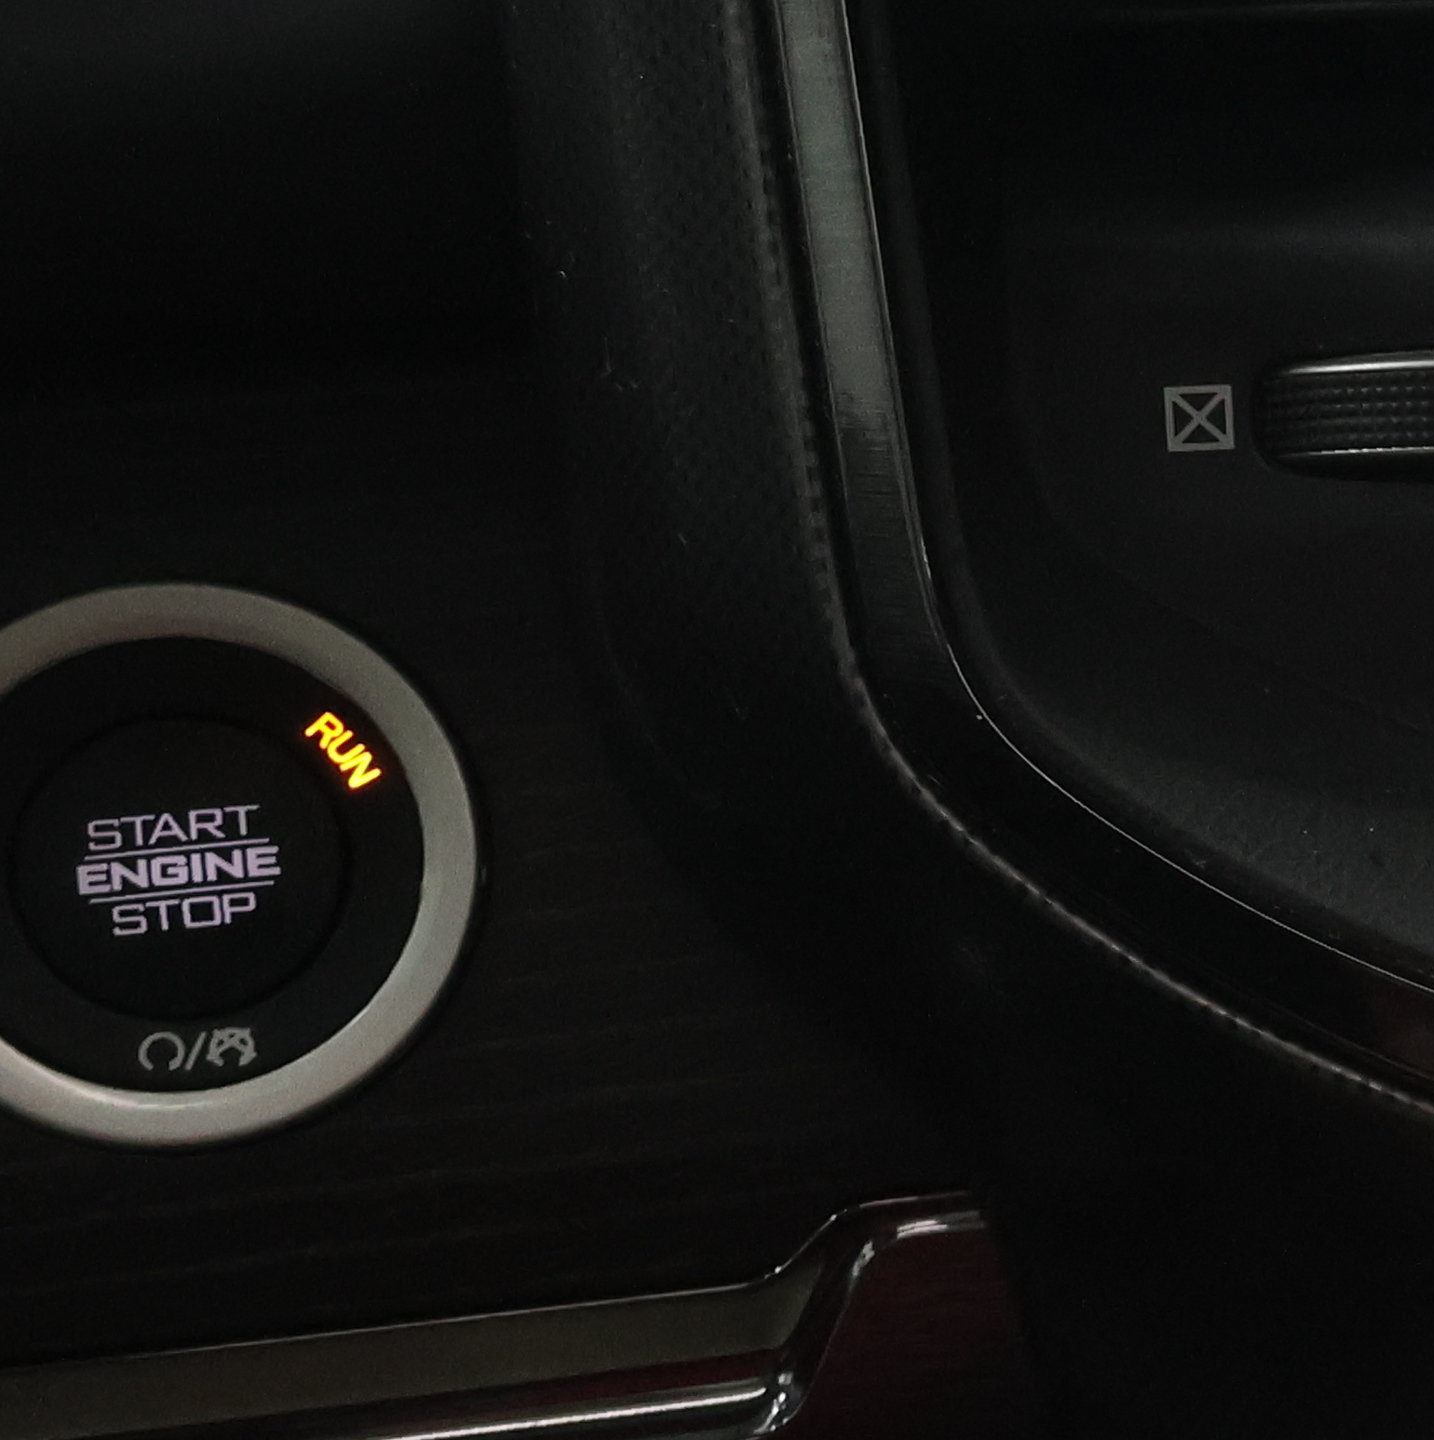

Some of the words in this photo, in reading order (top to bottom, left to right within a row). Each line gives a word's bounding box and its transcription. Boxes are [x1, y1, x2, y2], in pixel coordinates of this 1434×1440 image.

[304, 710, 382, 790] RUN
[88, 803, 261, 852] START
[75, 845, 282, 896] ENGINE
[111, 891, 257, 937] STOP
